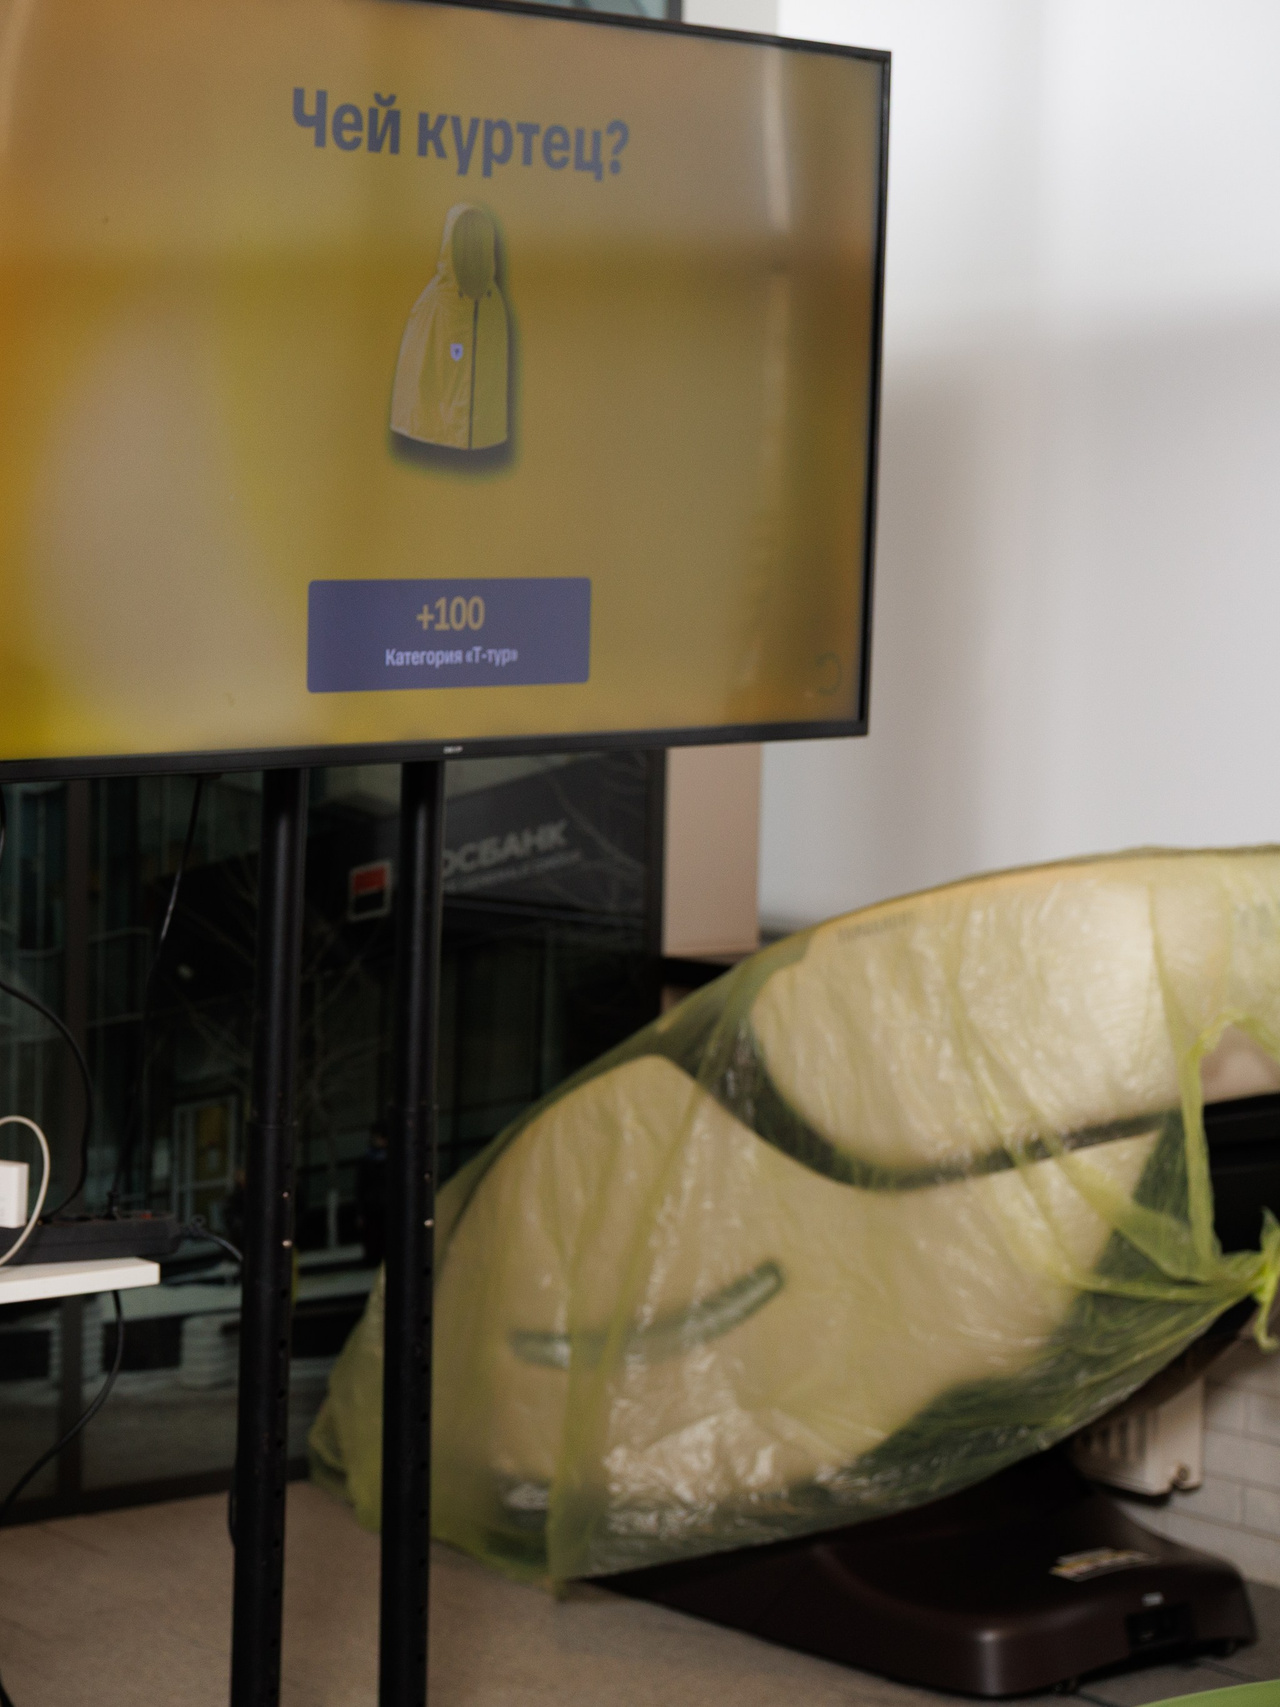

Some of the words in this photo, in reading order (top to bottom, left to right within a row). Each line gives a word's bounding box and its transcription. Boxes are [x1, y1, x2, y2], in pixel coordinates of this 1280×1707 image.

[293, 87, 401, 155] Чей
[417, 111, 630, 181] куртец?
[416, 596, 485, 631] +100
[385, 648, 463, 669] Категория
[465, 645, 519, 667] «Т-тур»
